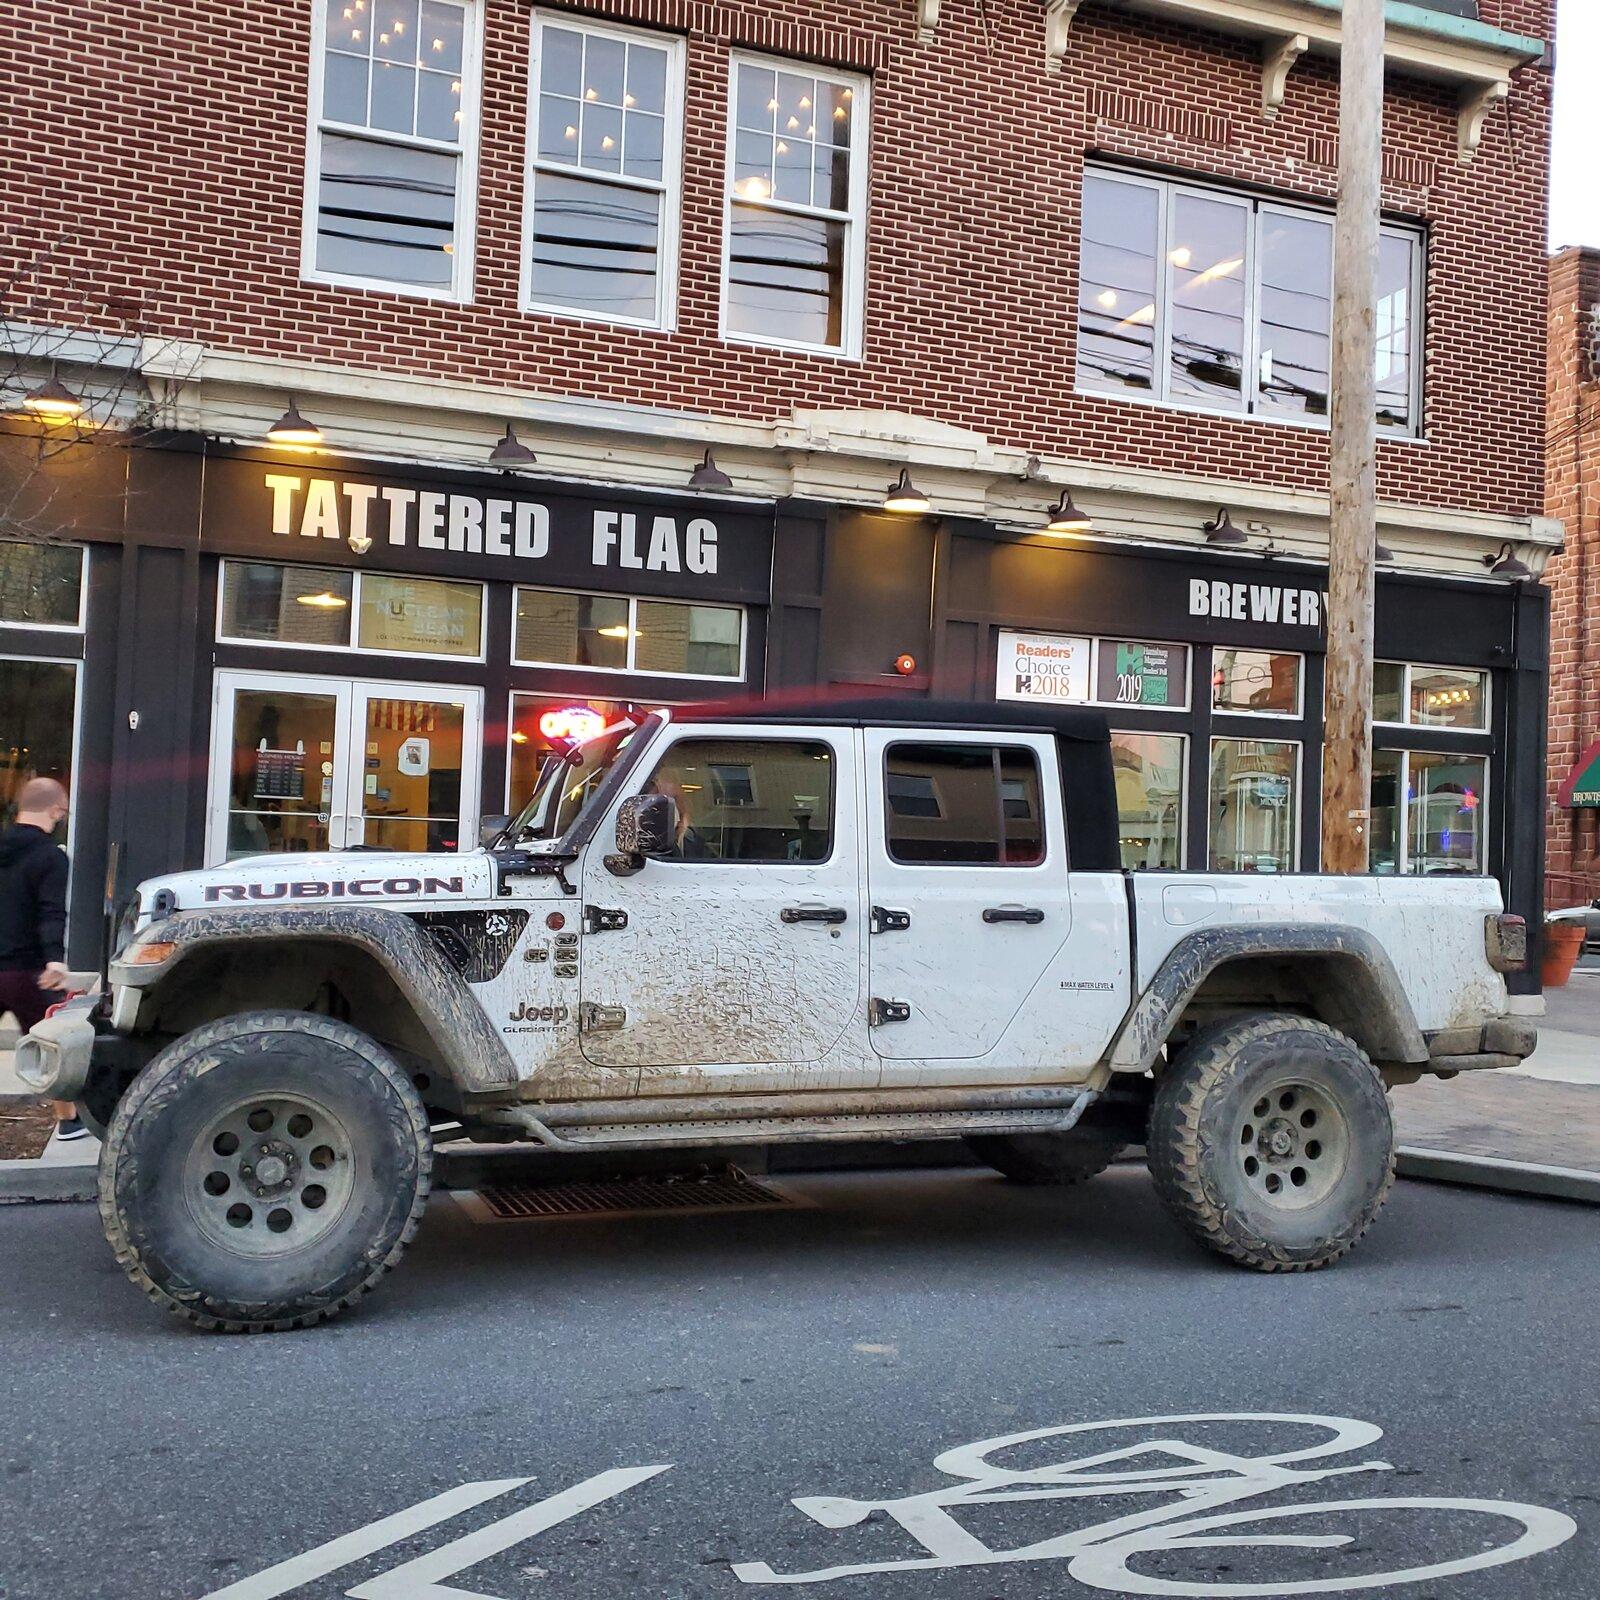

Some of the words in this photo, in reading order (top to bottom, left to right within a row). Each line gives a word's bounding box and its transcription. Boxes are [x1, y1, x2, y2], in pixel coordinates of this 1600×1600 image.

[265, 474, 550, 558] TATTERED
[592, 510, 718, 574] FLAG
[1016, 643, 1074, 659] Readers'
[1015, 657, 1071, 676] Choice
[1032, 675, 1070, 697] 2018
[1116, 674, 1142, 702] 2019
[205, 876, 464, 902] RUBICON
[509, 1002, 569, 1026] Jeep
[502, 1026, 568, 1034] GLADIATOR
